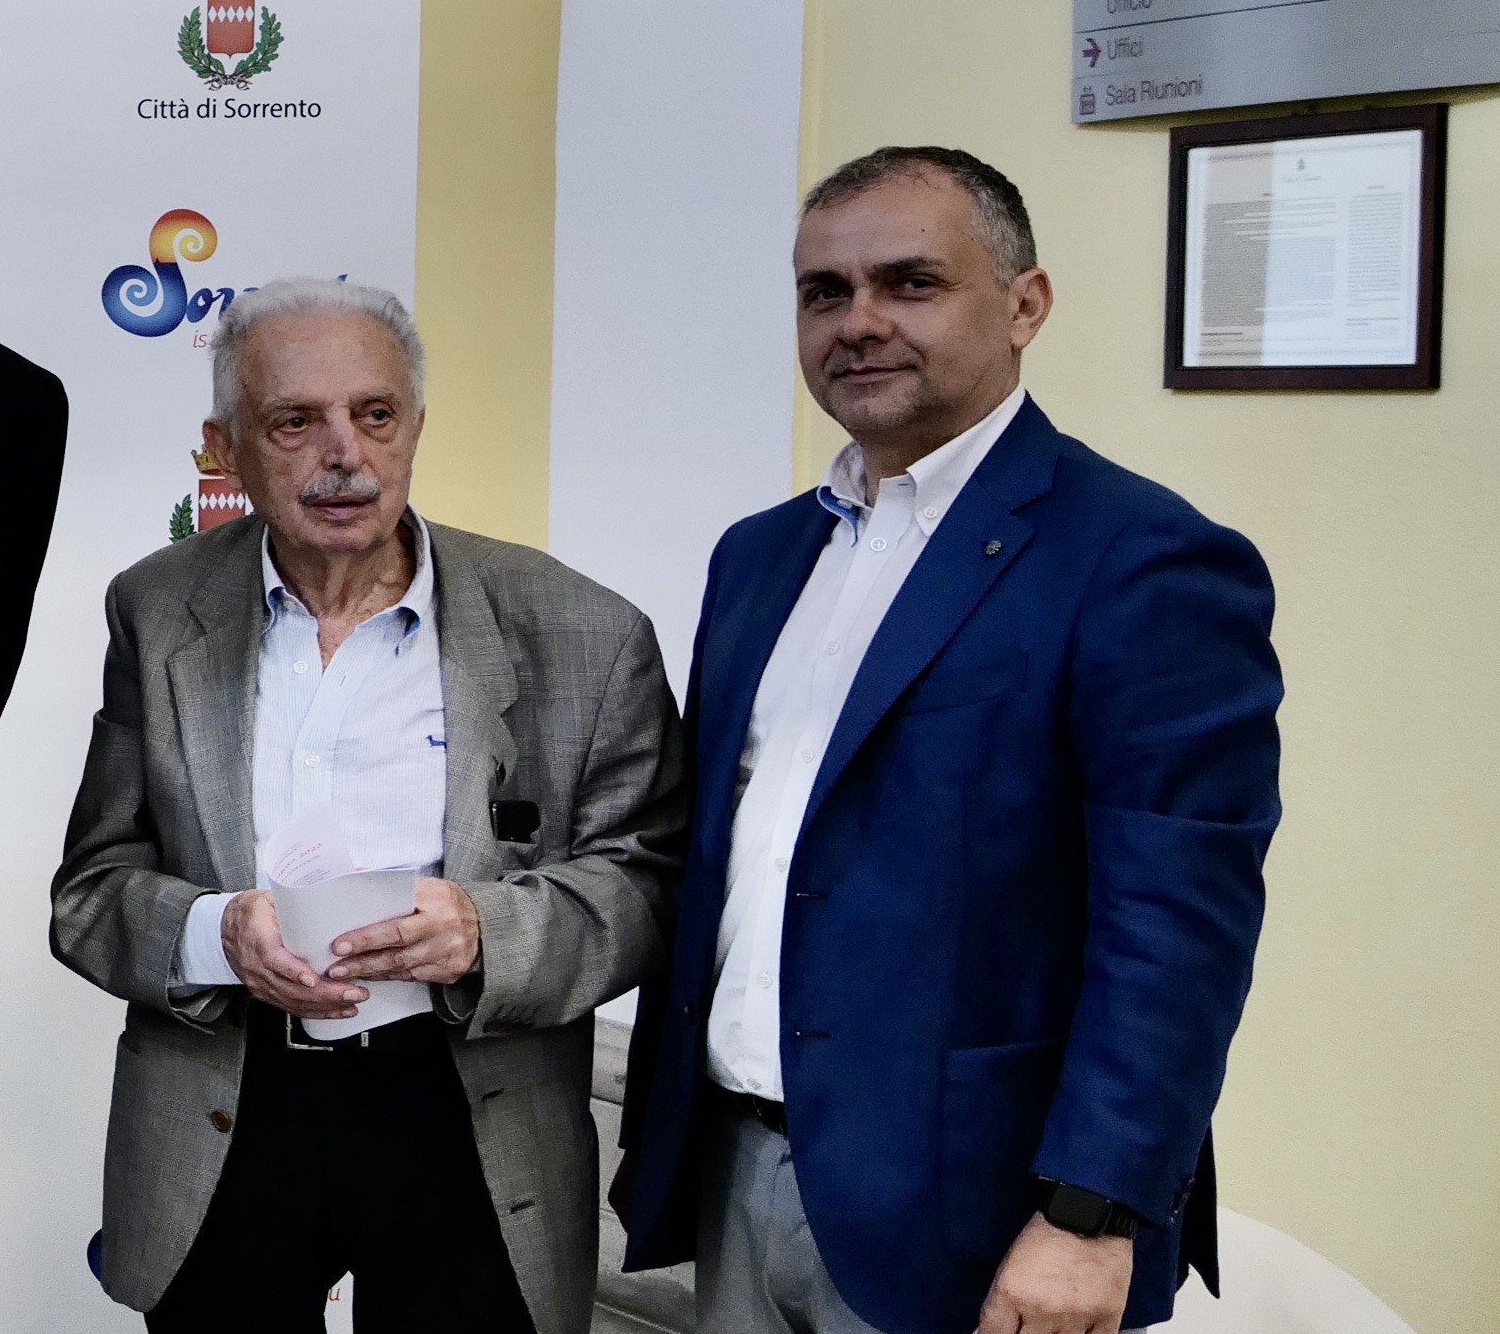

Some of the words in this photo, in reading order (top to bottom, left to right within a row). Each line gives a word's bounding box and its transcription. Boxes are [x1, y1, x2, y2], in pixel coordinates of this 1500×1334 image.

[1107, 36, 1143, 60] Uffici
[1106, 83, 1136, 107] Sala
[1140, 74, 1203, 97] Riunioni
[138, 99, 188, 119] Città
[197, 98, 216, 118] di
[224, 99, 321, 118] Sorrento
[193, 330, 210, 348] is
